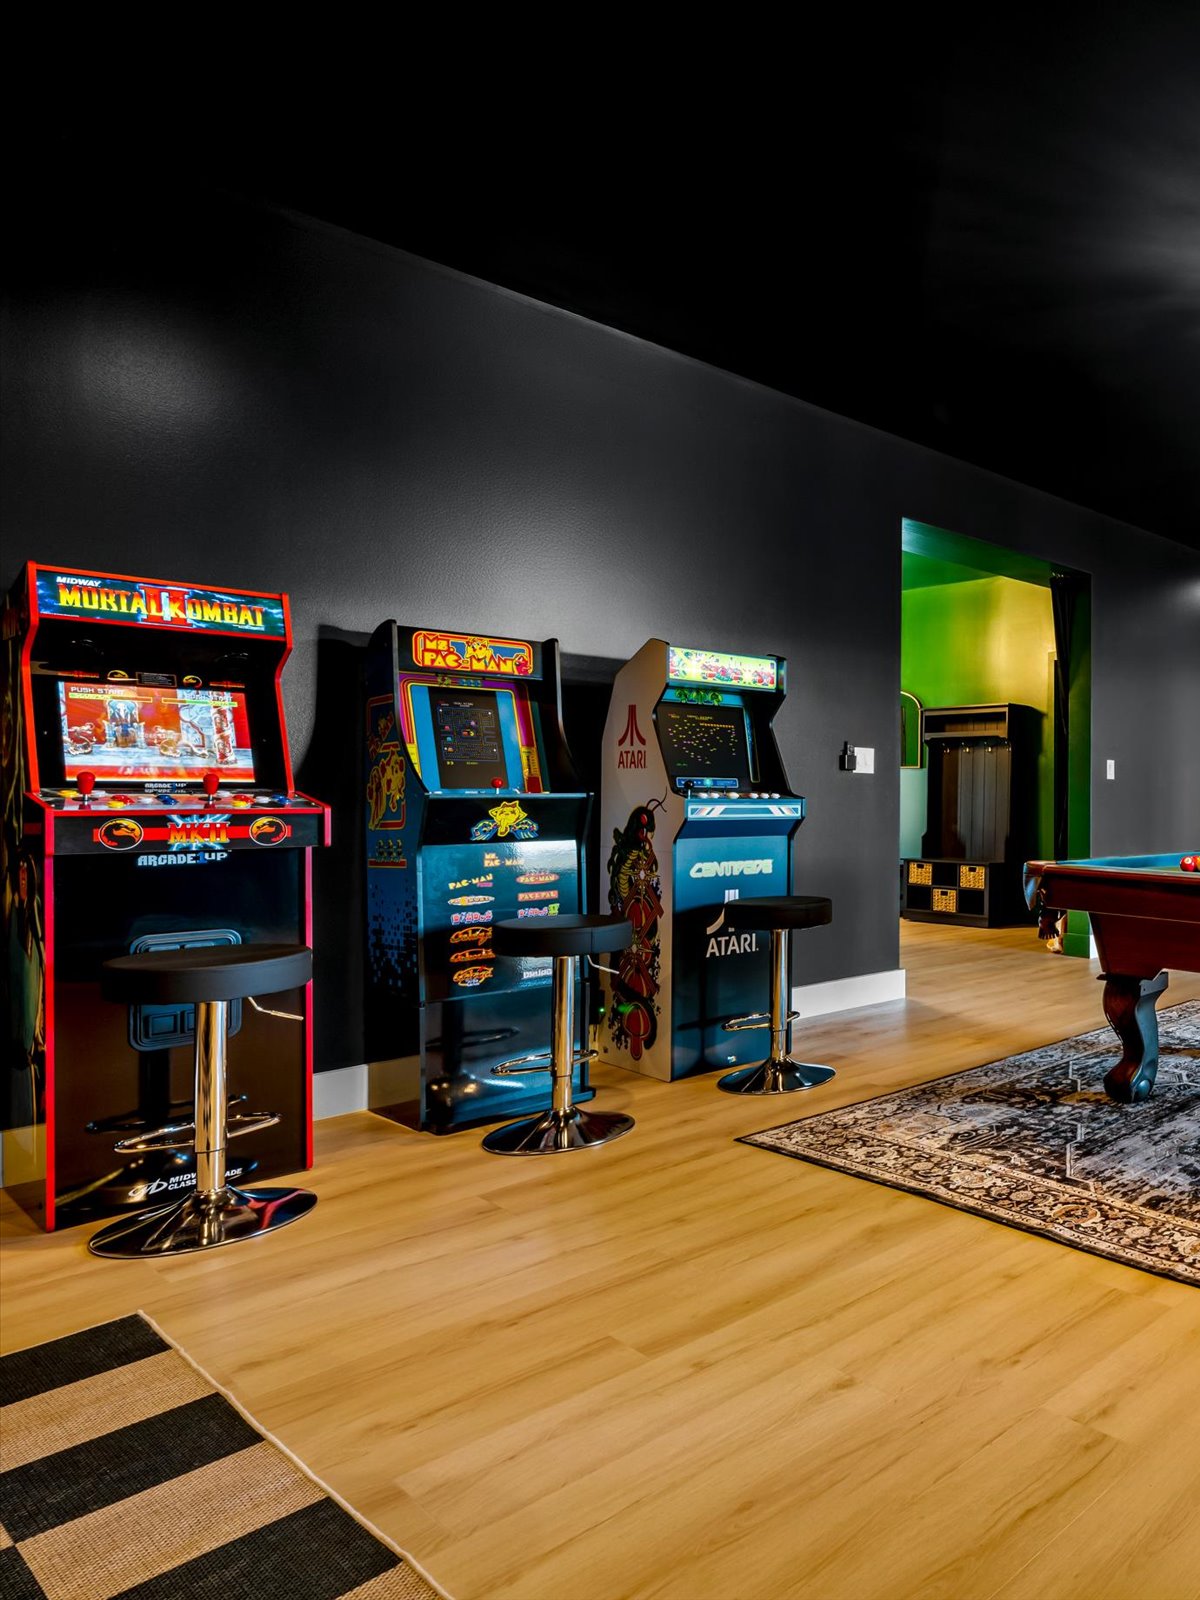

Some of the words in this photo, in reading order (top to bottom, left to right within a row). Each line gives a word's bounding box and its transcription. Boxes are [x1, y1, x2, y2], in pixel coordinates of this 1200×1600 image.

[56, 576, 101, 587] MIDWAY
[57, 583, 164, 617] MORTAL
[169, 597, 265, 627] KOMBAT
[422, 652, 514, 673] PAC-MAN
[70, 686, 95, 694] PUSH
[99, 688, 126, 696] START
[617, 750, 647, 769] ATARI
[137, 851, 228, 867] ARCADE1UP
[449, 873, 493, 890] PAC-MAN
[706, 933, 756, 958] ATARI
